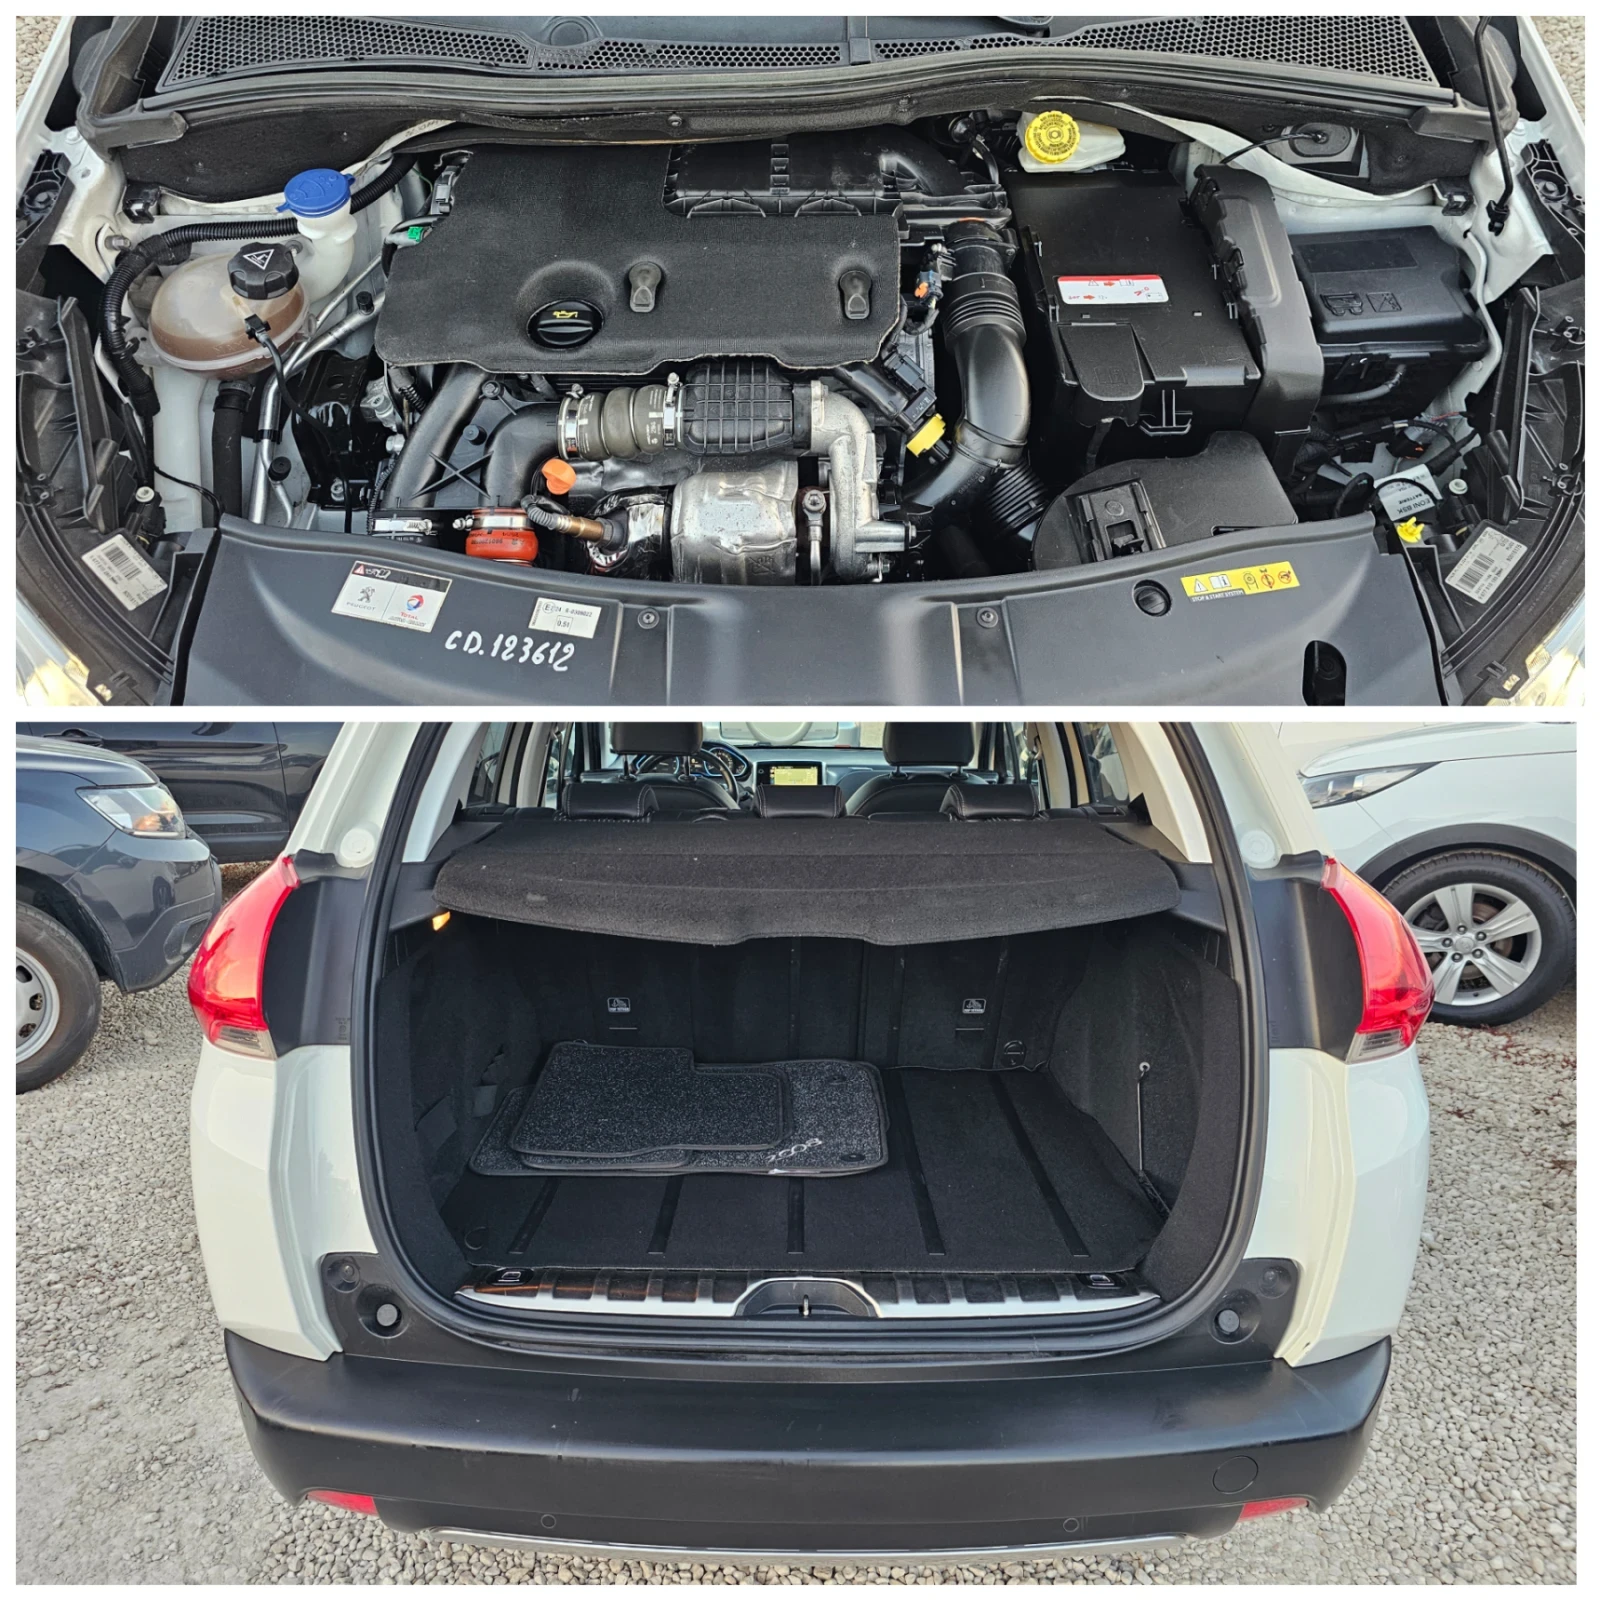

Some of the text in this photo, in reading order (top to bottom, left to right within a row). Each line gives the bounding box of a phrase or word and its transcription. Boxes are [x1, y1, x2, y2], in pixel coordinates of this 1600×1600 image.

[1224, 589, 1244, 597] SYSTEM
[346, 601, 376, 611] PEUGEOT
[400, 611, 419, 620] TOTAL
